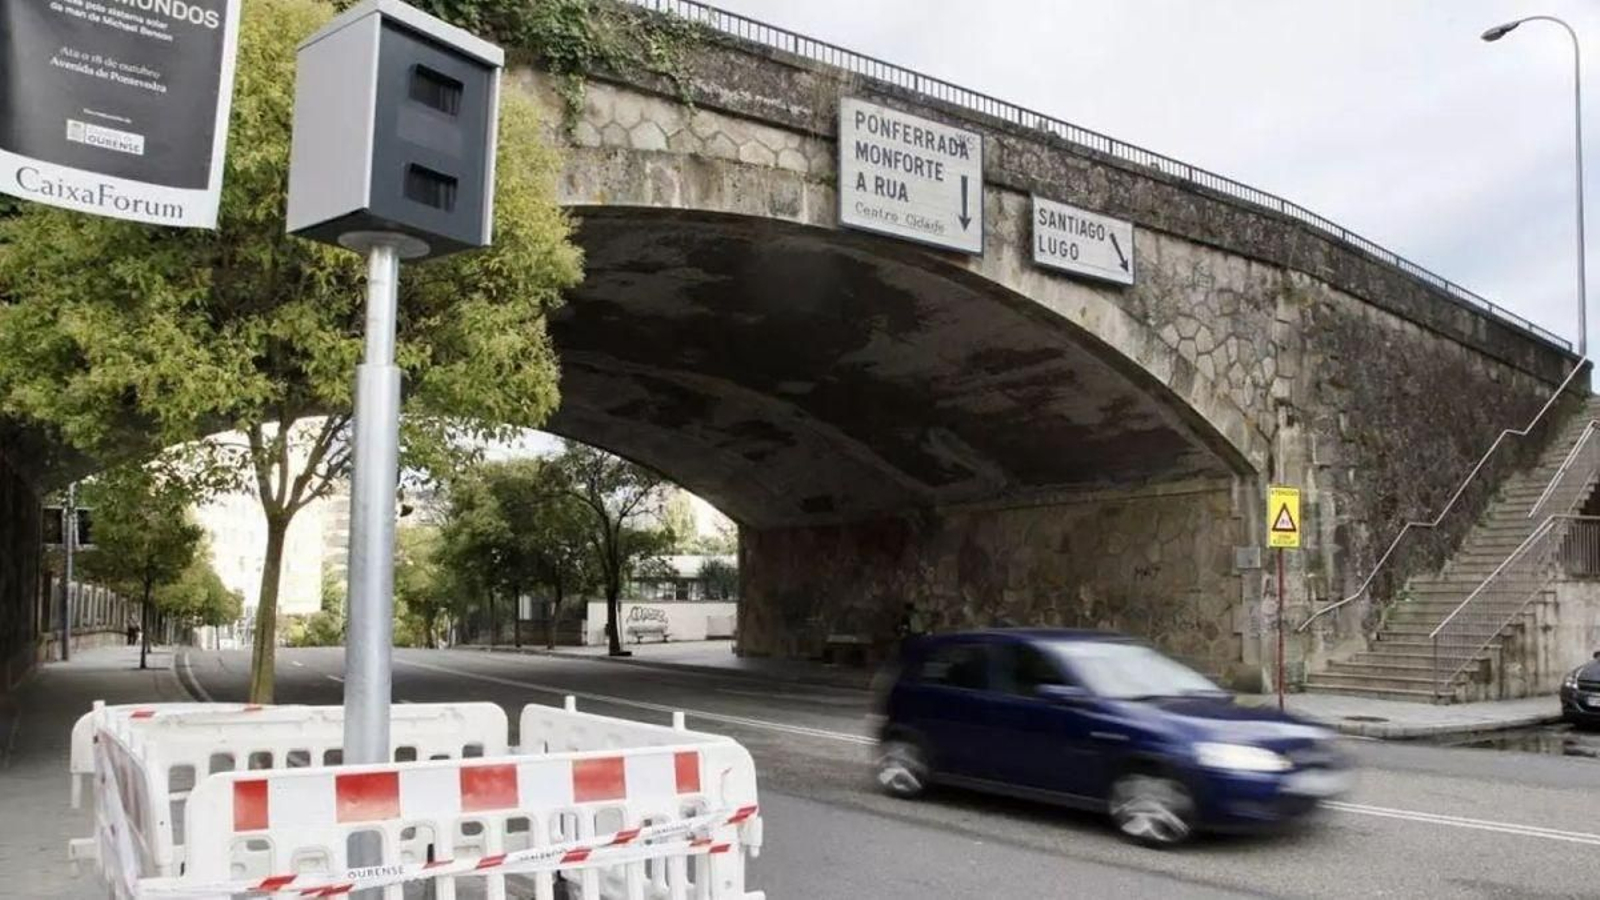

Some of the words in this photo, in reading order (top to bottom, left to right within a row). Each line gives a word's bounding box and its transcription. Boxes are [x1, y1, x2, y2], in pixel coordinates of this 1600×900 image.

[87, 12, 100, 23] de
[102, 15, 138, 33] Michael
[140, 25, 173, 42] Benson
[107, 7, 145, 24] sistema
[114, 0, 219, 28] UNDOS
[49, 56, 94, 75] Avenida
[95, 67, 109, 79] de
[110, 71, 167, 93] Pontevedra
[103, 57, 118, 69] de
[119, 62, 160, 80] outubro
[87, 134, 141, 153] OURENSE
[855, 110, 969, 160] PONFERRADA
[855, 140, 944, 182] MONFORTE
[15, 165, 184, 219] CaixaForum
[855, 171, 867, 193] A
[874, 175, 909, 203] RUA
[855, 201, 899, 223] Centro
[1038, 207, 1105, 242] SANTIAGO
[1038, 234, 1079, 261] LUGO
[347, 865, 405, 879] OURENSE
